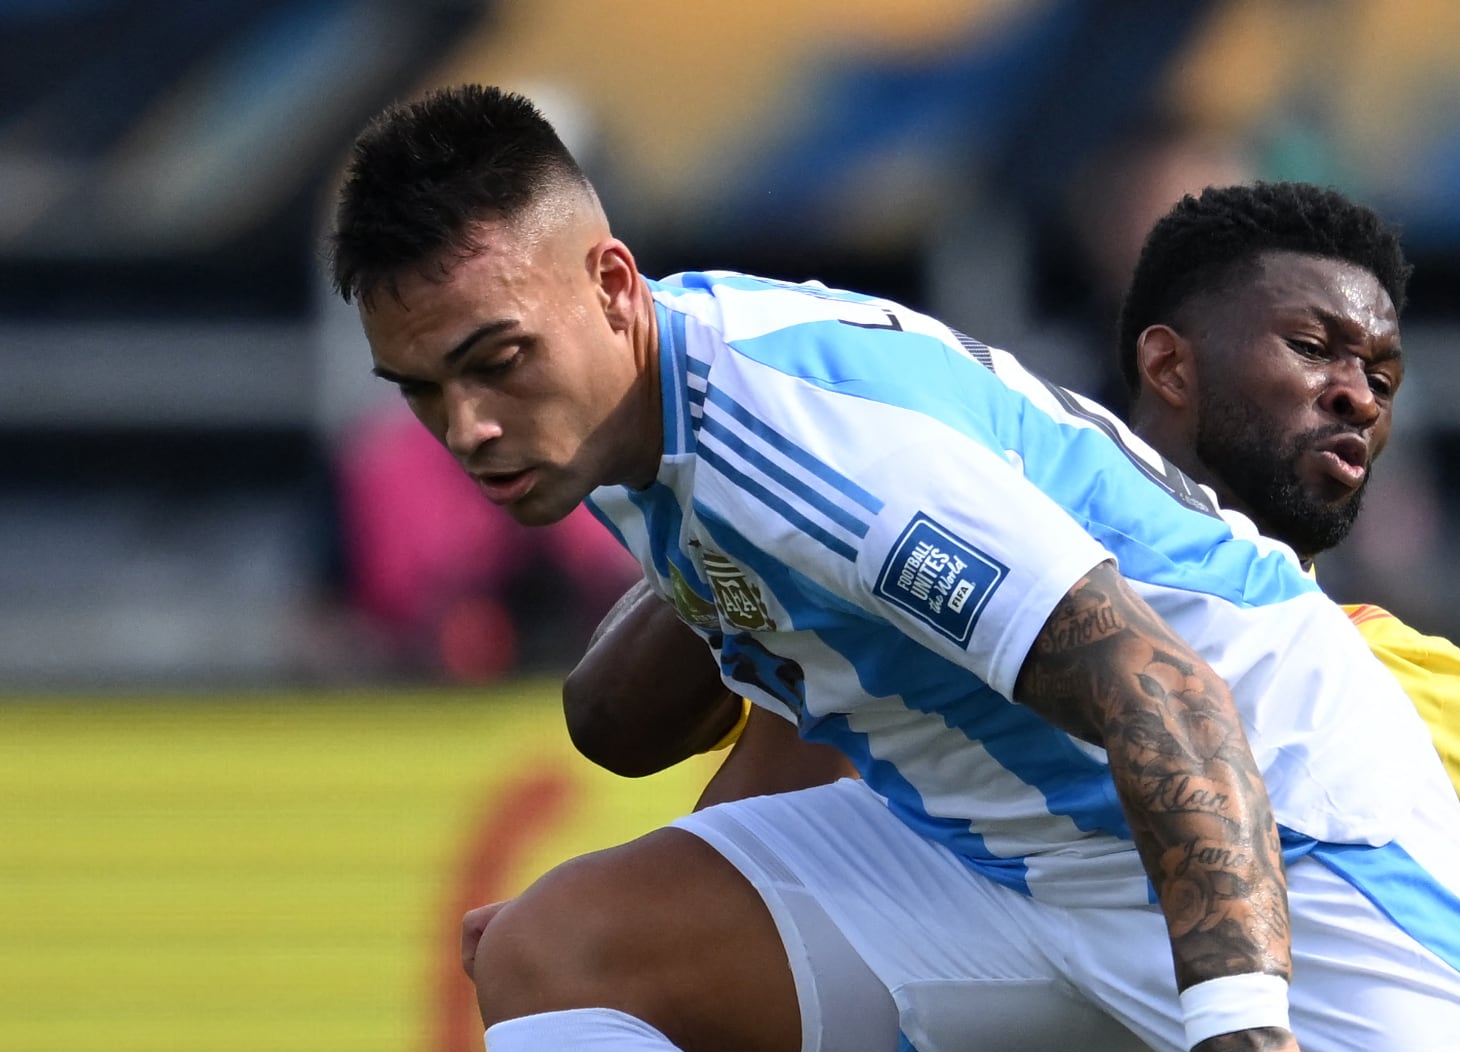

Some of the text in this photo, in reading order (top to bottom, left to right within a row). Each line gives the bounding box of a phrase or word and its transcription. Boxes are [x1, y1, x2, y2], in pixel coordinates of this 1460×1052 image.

[897, 541, 934, 591] FOOTBALL
[909, 548, 950, 601] UNITES
[928, 555, 968, 614] the World
[951, 586, 969, 608] FIFA
